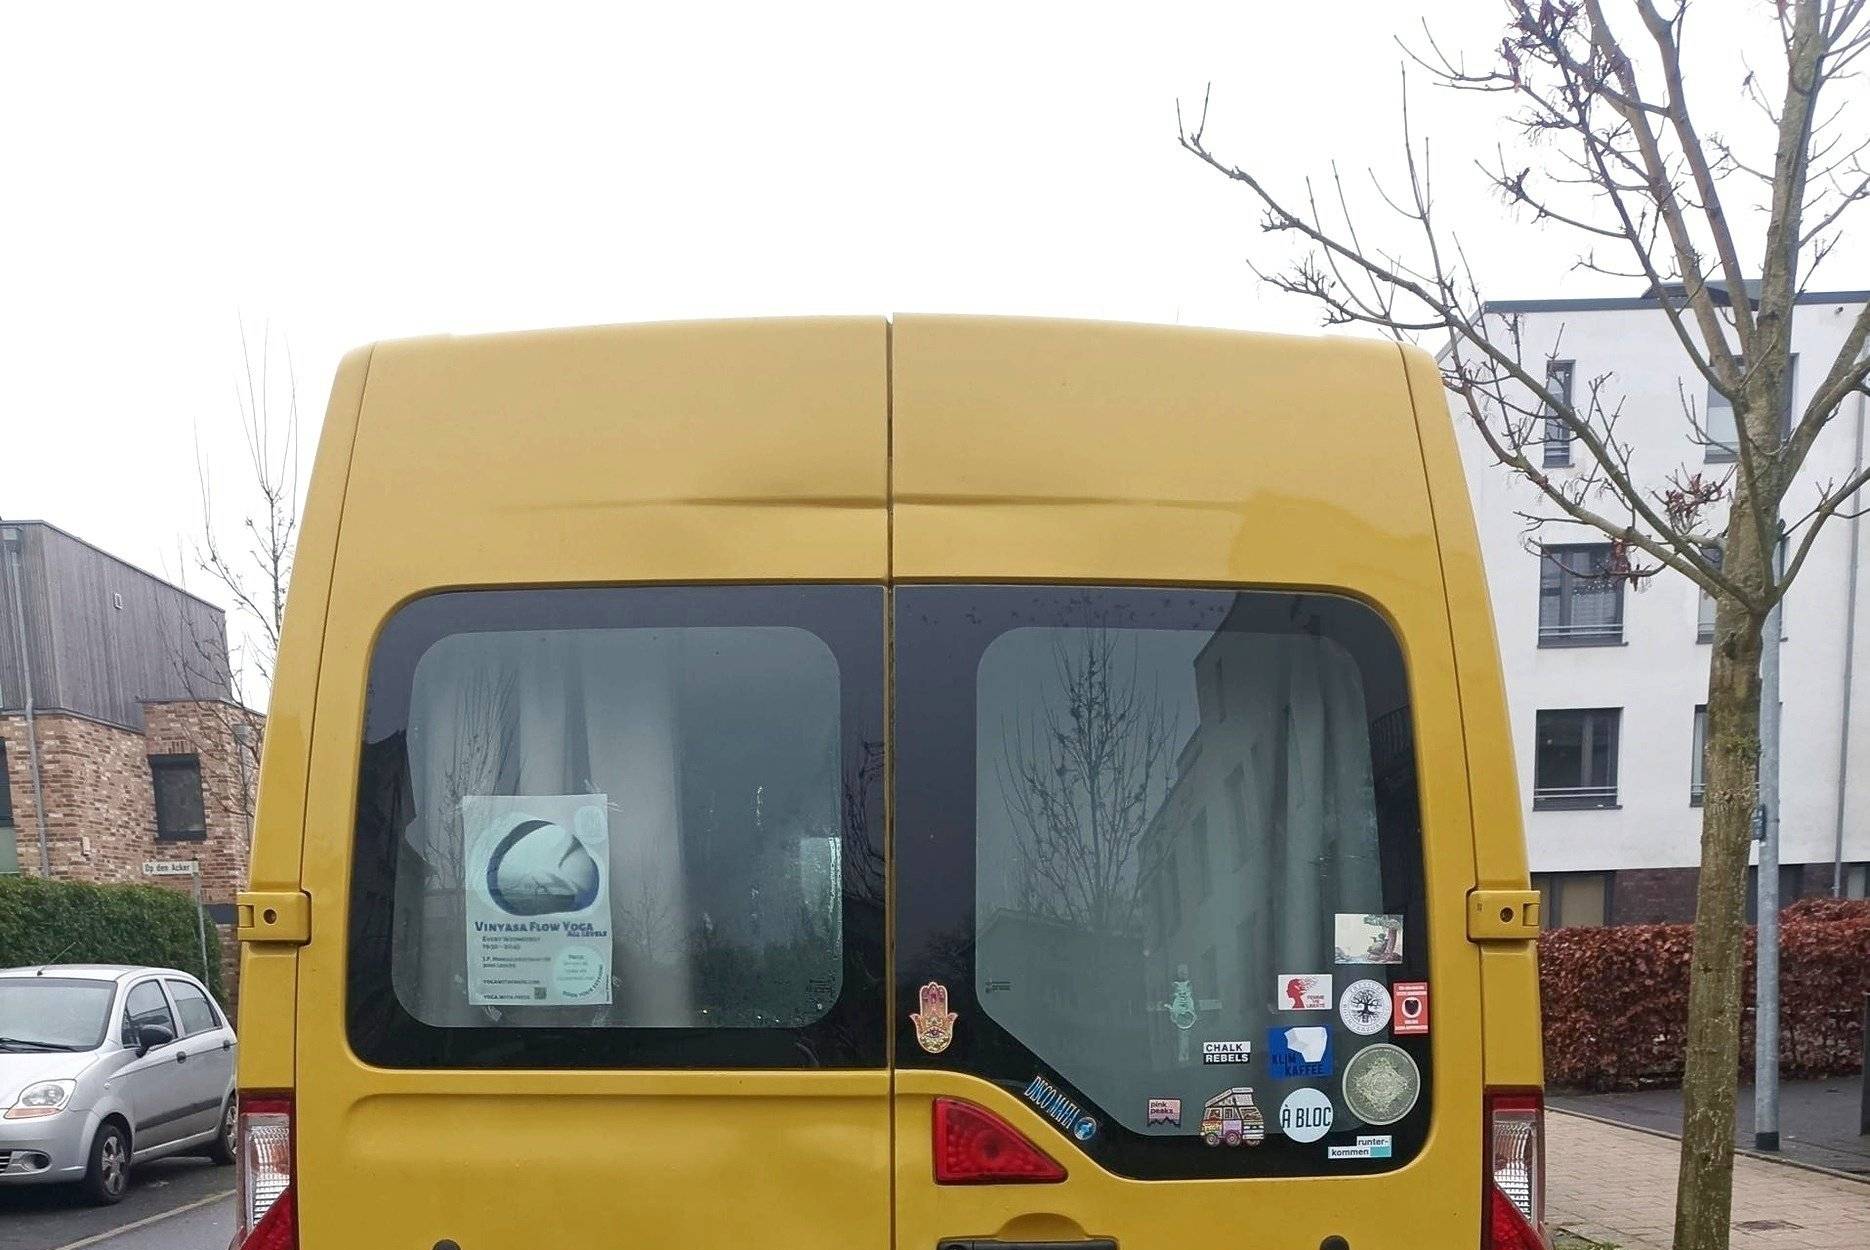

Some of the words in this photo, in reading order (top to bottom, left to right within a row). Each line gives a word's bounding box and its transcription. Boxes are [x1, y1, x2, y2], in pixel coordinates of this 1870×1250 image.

[475, 921, 528, 932] VINYASA
[529, 921, 560, 932] FLOW
[562, 921, 593, 931] YOGA
[1206, 1044, 1243, 1052] CHALK
[1205, 1053, 1249, 1063] REBELS
[1285, 1064, 1324, 1077] KAFFEE
[1024, 1075, 1057, 1109] DISCO
[1046, 1093, 1081, 1130] MAFIA
[1150, 1101, 1167, 1109] pink
[1150, 1107, 1174, 1116] peaks
[1281, 1104, 1291, 1128] À
[1296, 1107, 1331, 1128] BLOC
[1358, 1138, 1389, 1146] runter-
[1331, 1148, 1370, 1157] kommen
